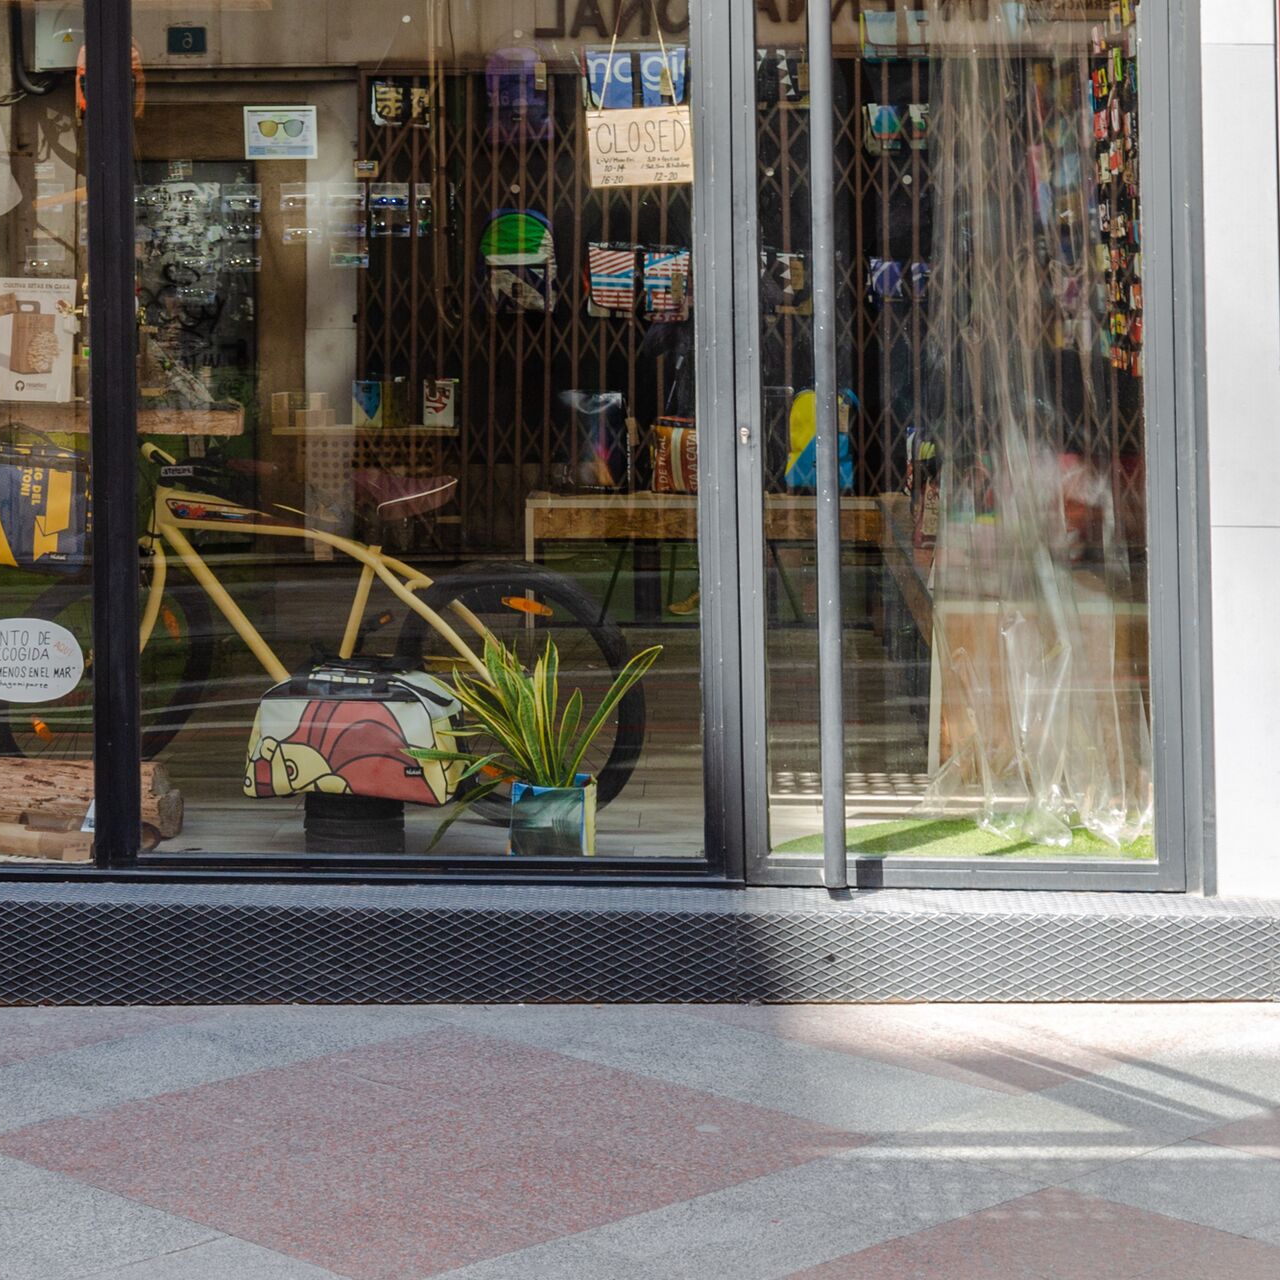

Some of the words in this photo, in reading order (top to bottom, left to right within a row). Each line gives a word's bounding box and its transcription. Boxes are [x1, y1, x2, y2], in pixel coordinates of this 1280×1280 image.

[596, 119, 686, 154] CLOSED
[38, 631, 51, 646] DE
[28, 666, 39, 678] EN
[40, 666, 49, 678] EL
